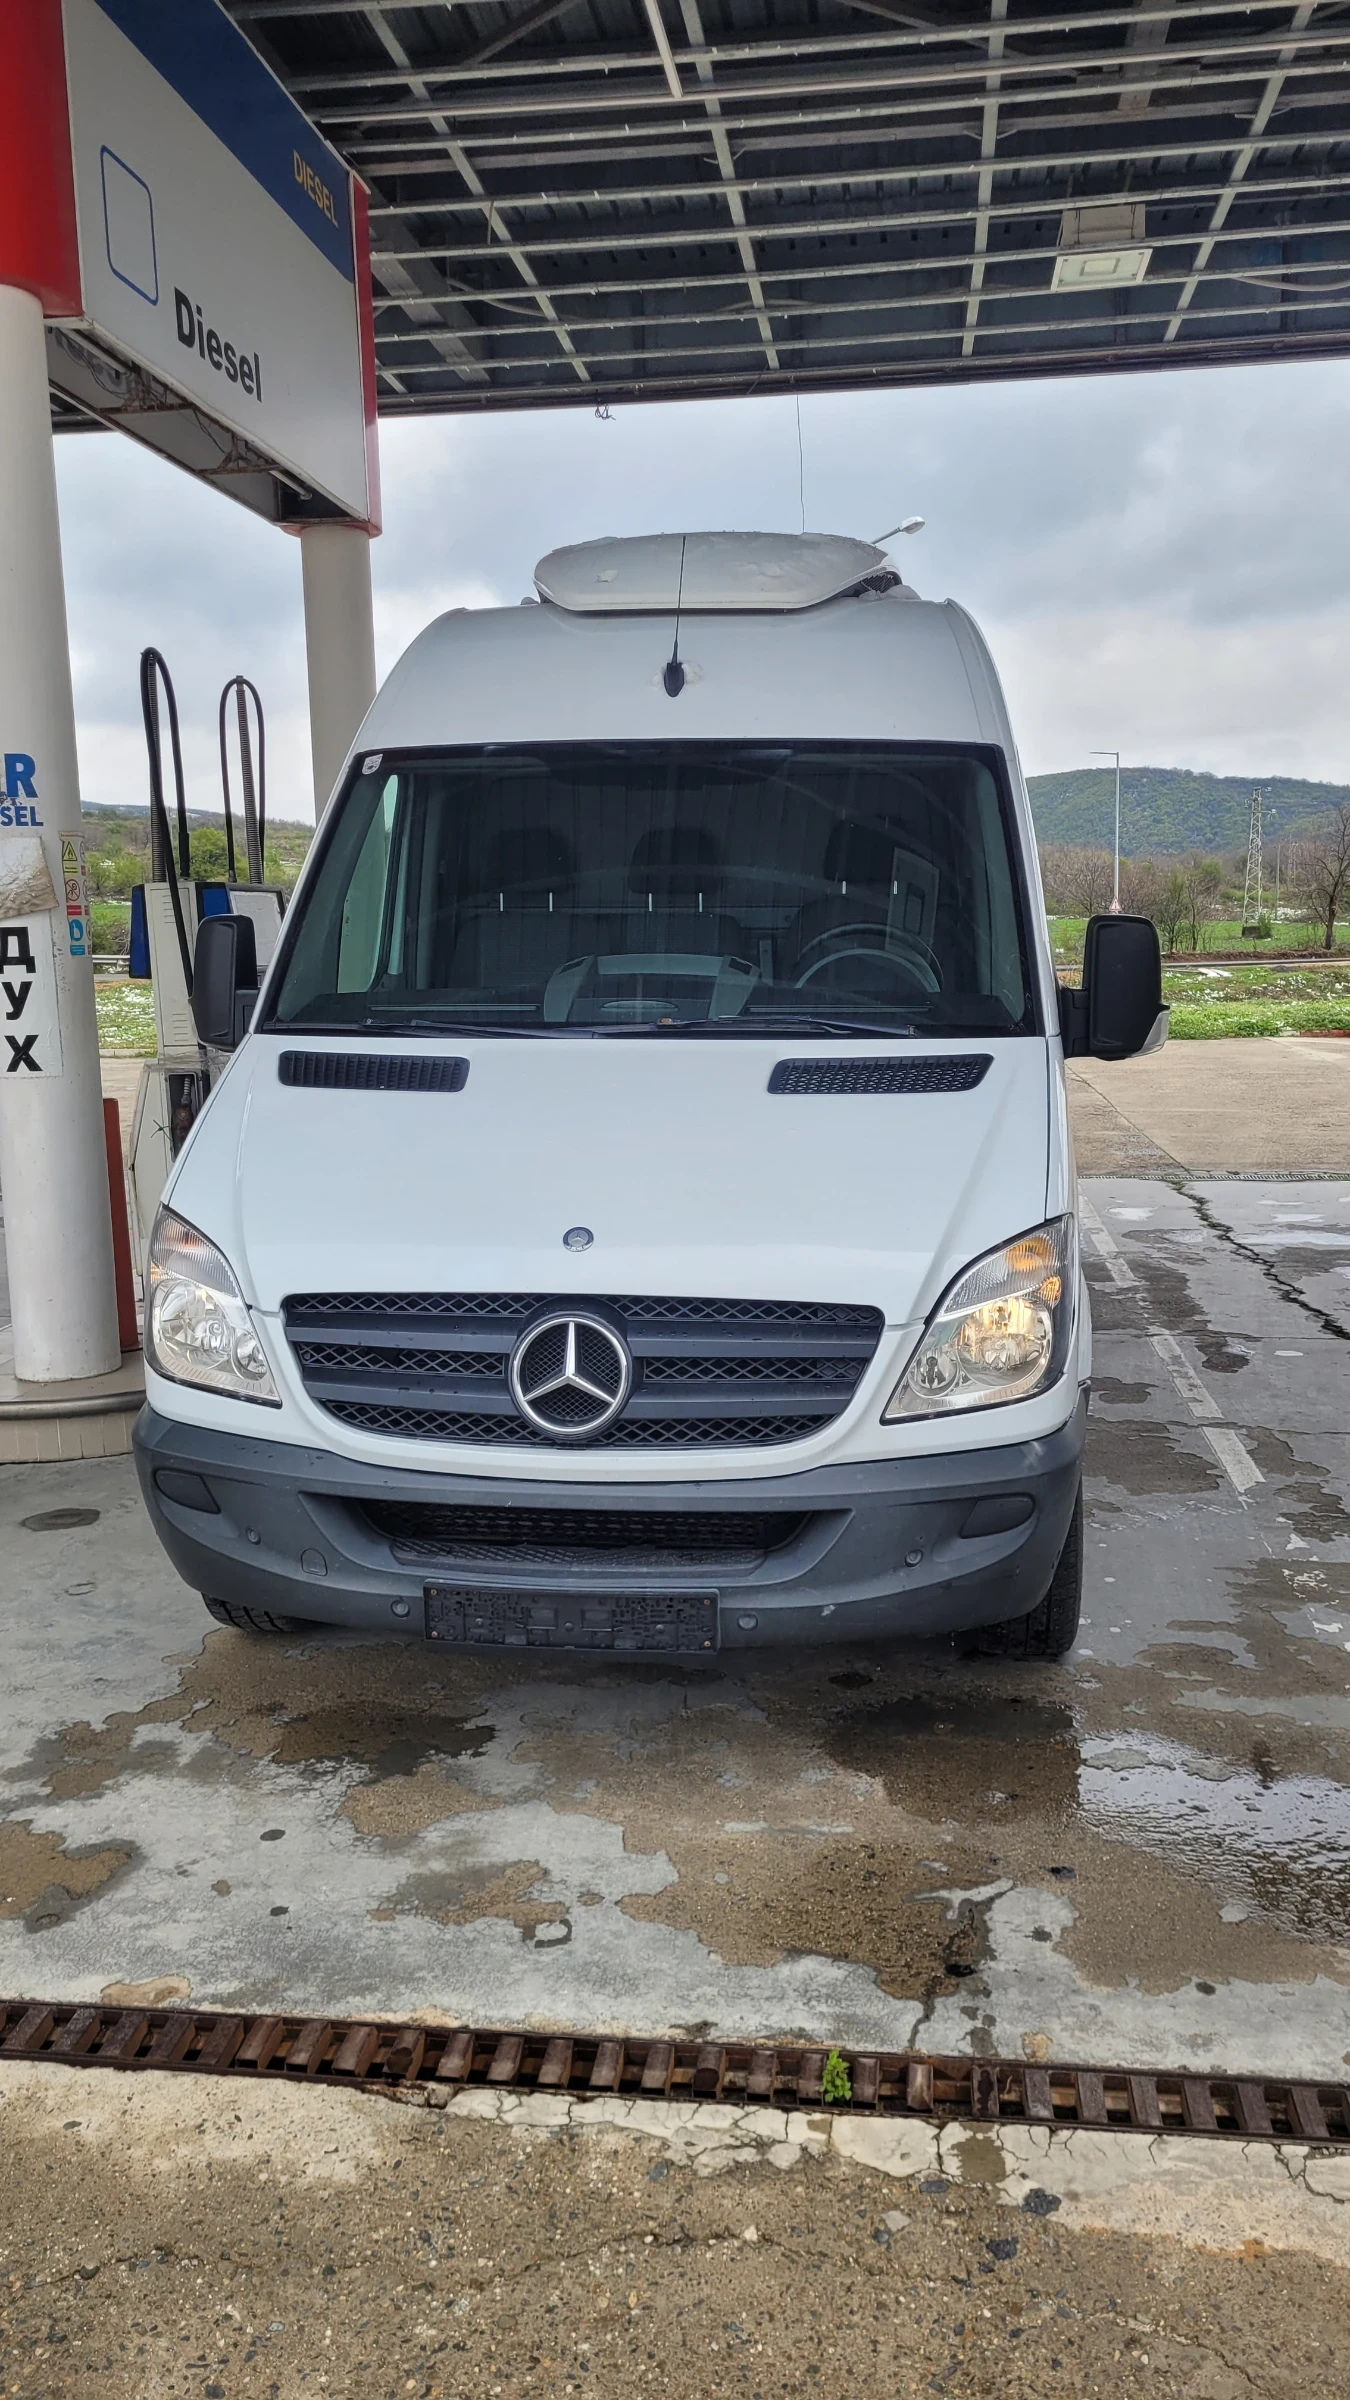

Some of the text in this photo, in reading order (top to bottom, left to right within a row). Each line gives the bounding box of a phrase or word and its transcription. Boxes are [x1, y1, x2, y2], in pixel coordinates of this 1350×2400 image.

[293, 149, 339, 228] DIESEL
[174, 286, 262, 403] Diesel
[4, 753, 39, 798] R
[0, 806, 44, 826] SEL
